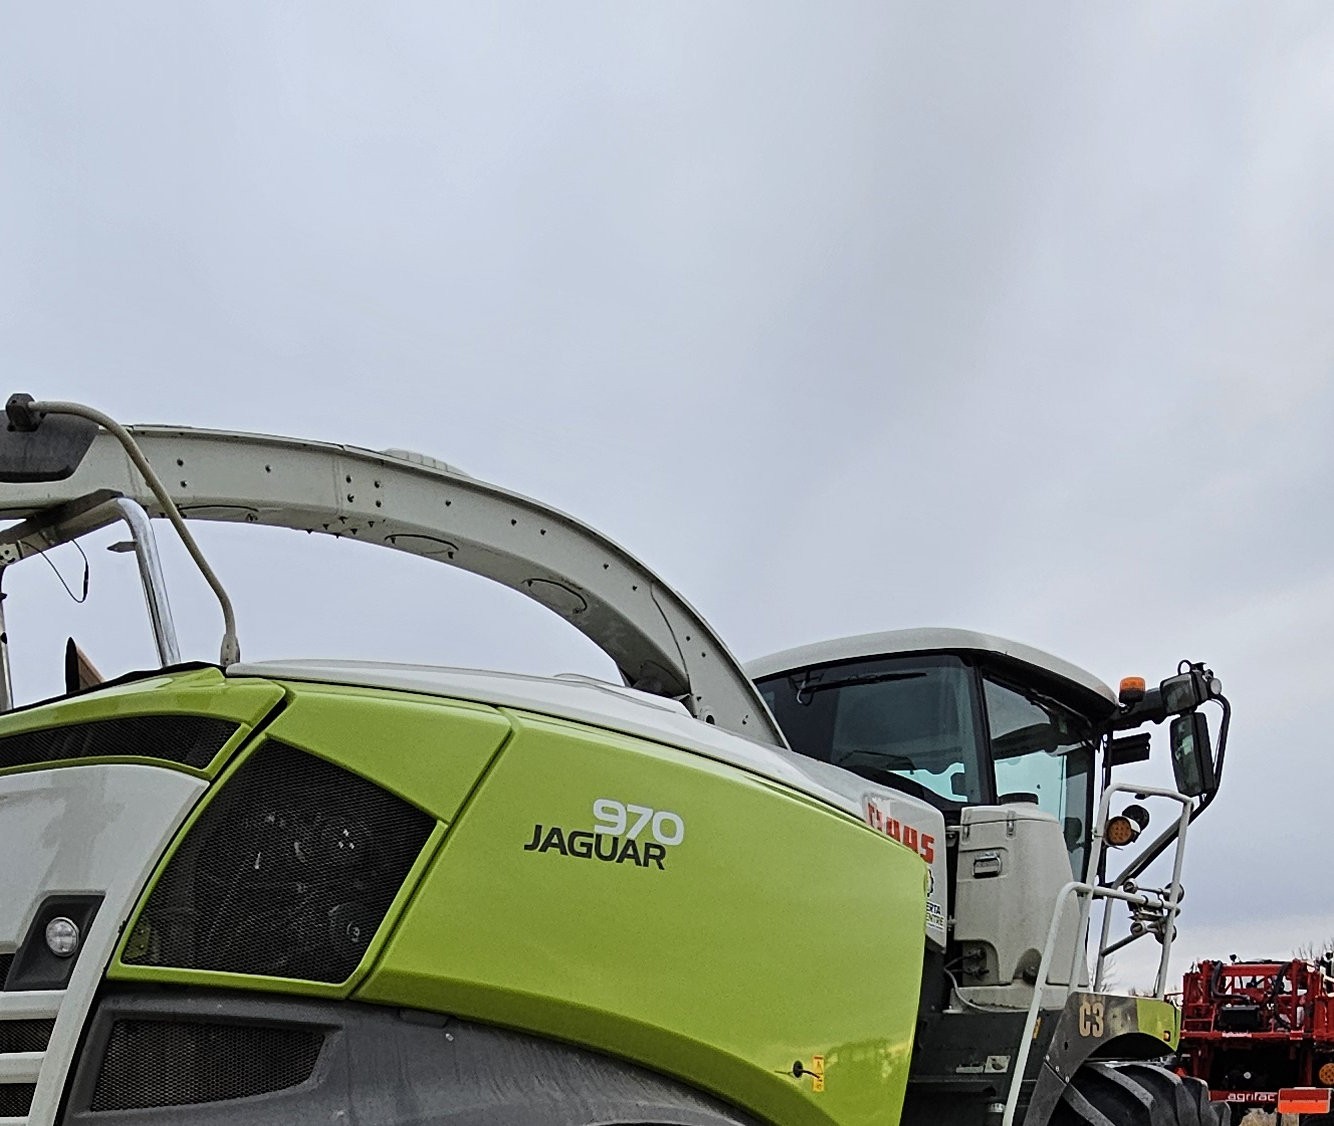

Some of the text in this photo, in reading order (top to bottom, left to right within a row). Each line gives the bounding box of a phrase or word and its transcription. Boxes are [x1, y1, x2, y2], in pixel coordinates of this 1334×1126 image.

[593, 798, 684, 846] 970
[524, 824, 666, 870] JAGUAR
[1079, 1001, 1104, 1038] C3
[1227, 1091, 1278, 1102] agrifac
